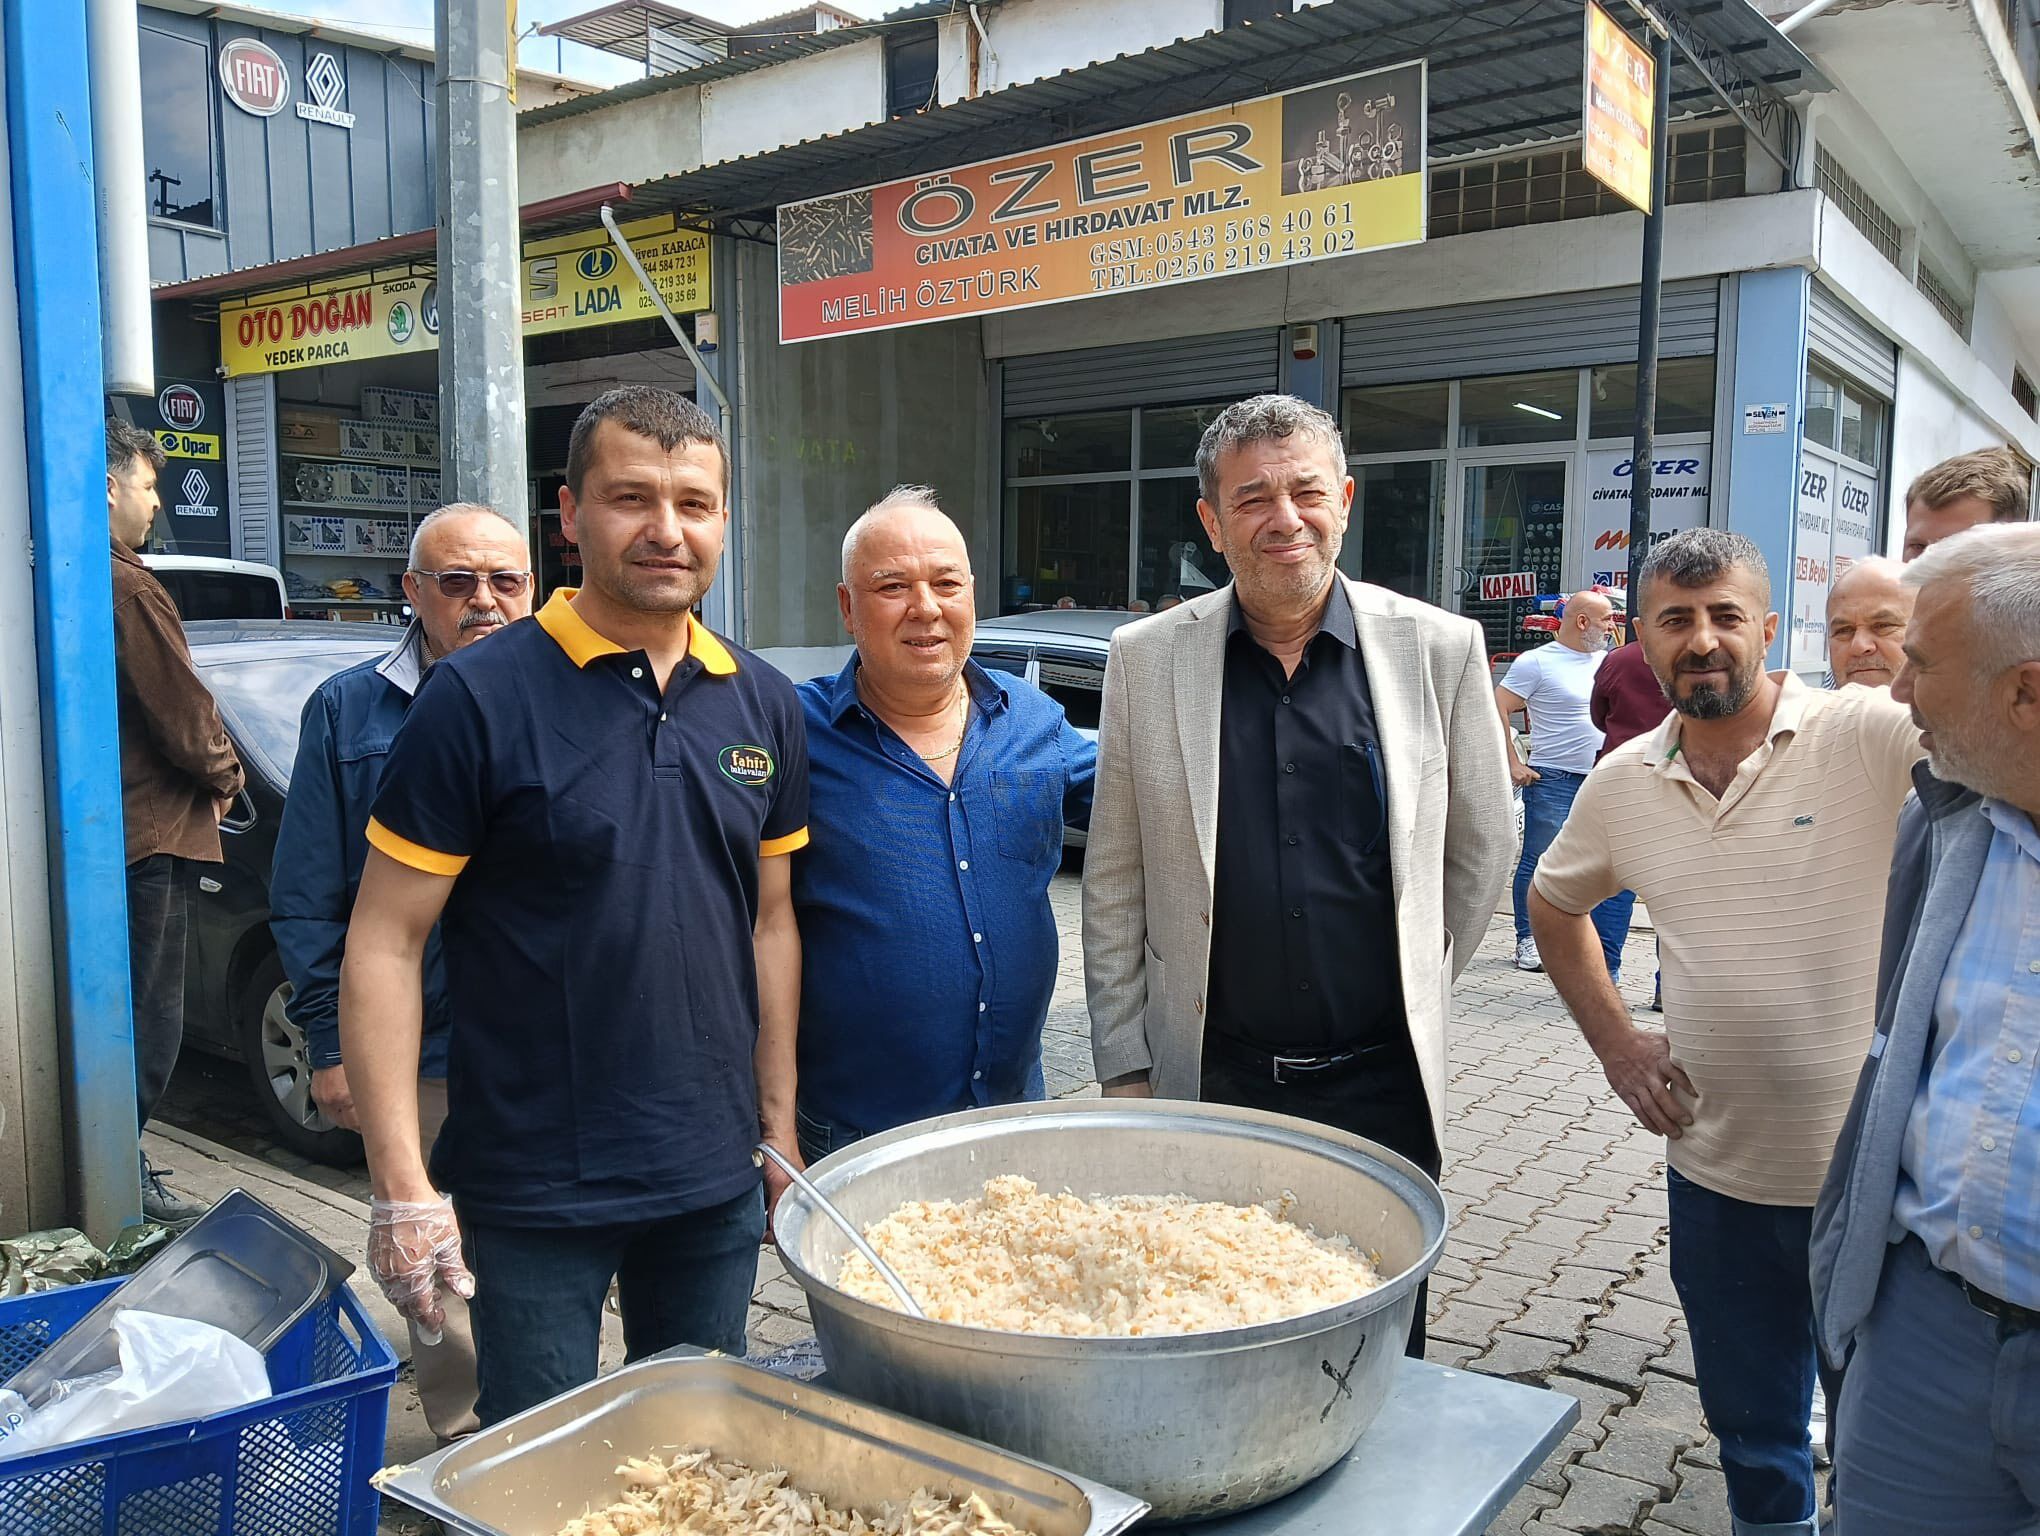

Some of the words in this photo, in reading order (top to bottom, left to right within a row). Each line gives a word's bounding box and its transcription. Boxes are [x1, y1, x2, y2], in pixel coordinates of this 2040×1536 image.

[236, 59, 275, 98] FIAT
[300, 104, 353, 125] RENAULT
[897, 121, 1264, 237] ÖZER
[915, 231, 997, 266] CIVATA
[1004, 224, 1037, 249] VE
[1044, 198, 1174, 243] HIRDAVAT
[1184, 184, 1250, 218] MLZ.
[1225, 214, 1271, 244] 568
[1281, 208, 1312, 234] 40
[1323, 200, 1353, 227] 61
[634, 247, 659, 261] üven
[661, 237, 705, 256] KARACA
[1224, 241, 1272, 271] 219
[1281, 235, 1312, 262] 43
[1323, 229, 1355, 255] 02
[642, 261, 657, 274] 544
[659, 259, 673, 272] 584
[675, 257, 685, 270] 72
[687, 254, 696, 267] 31
[659, 276, 673, 289] 219
[675, 274, 685, 287] 33
[687, 271, 697, 284] 84
[575, 284, 622, 316] LADA
[638, 295, 656, 308] 025
[675, 290, 685, 302] 35
[687, 288, 696, 300] 69
[822, 287, 906, 323] MELİH
[916, 264, 1041, 308] ÖZTÜRK
[238, 307, 283, 348] OTO
[288, 288, 373, 340] DOĞAN
[521, 305, 569, 324] SEAT
[265, 348, 304, 366] YEDEK
[307, 341, 349, 360] PARÇA
[170, 399, 194, 418] FIAT
[182, 436, 211, 456] Opar
[1613, 459, 1700, 477] ÖER
[1801, 464, 1828, 503] ZER
[177, 506, 217, 516] RENAULT
[1842, 480, 1869, 517] ÖZER
[1482, 573, 1535, 599] KAPALI
[731, 750, 766, 769] fahir
